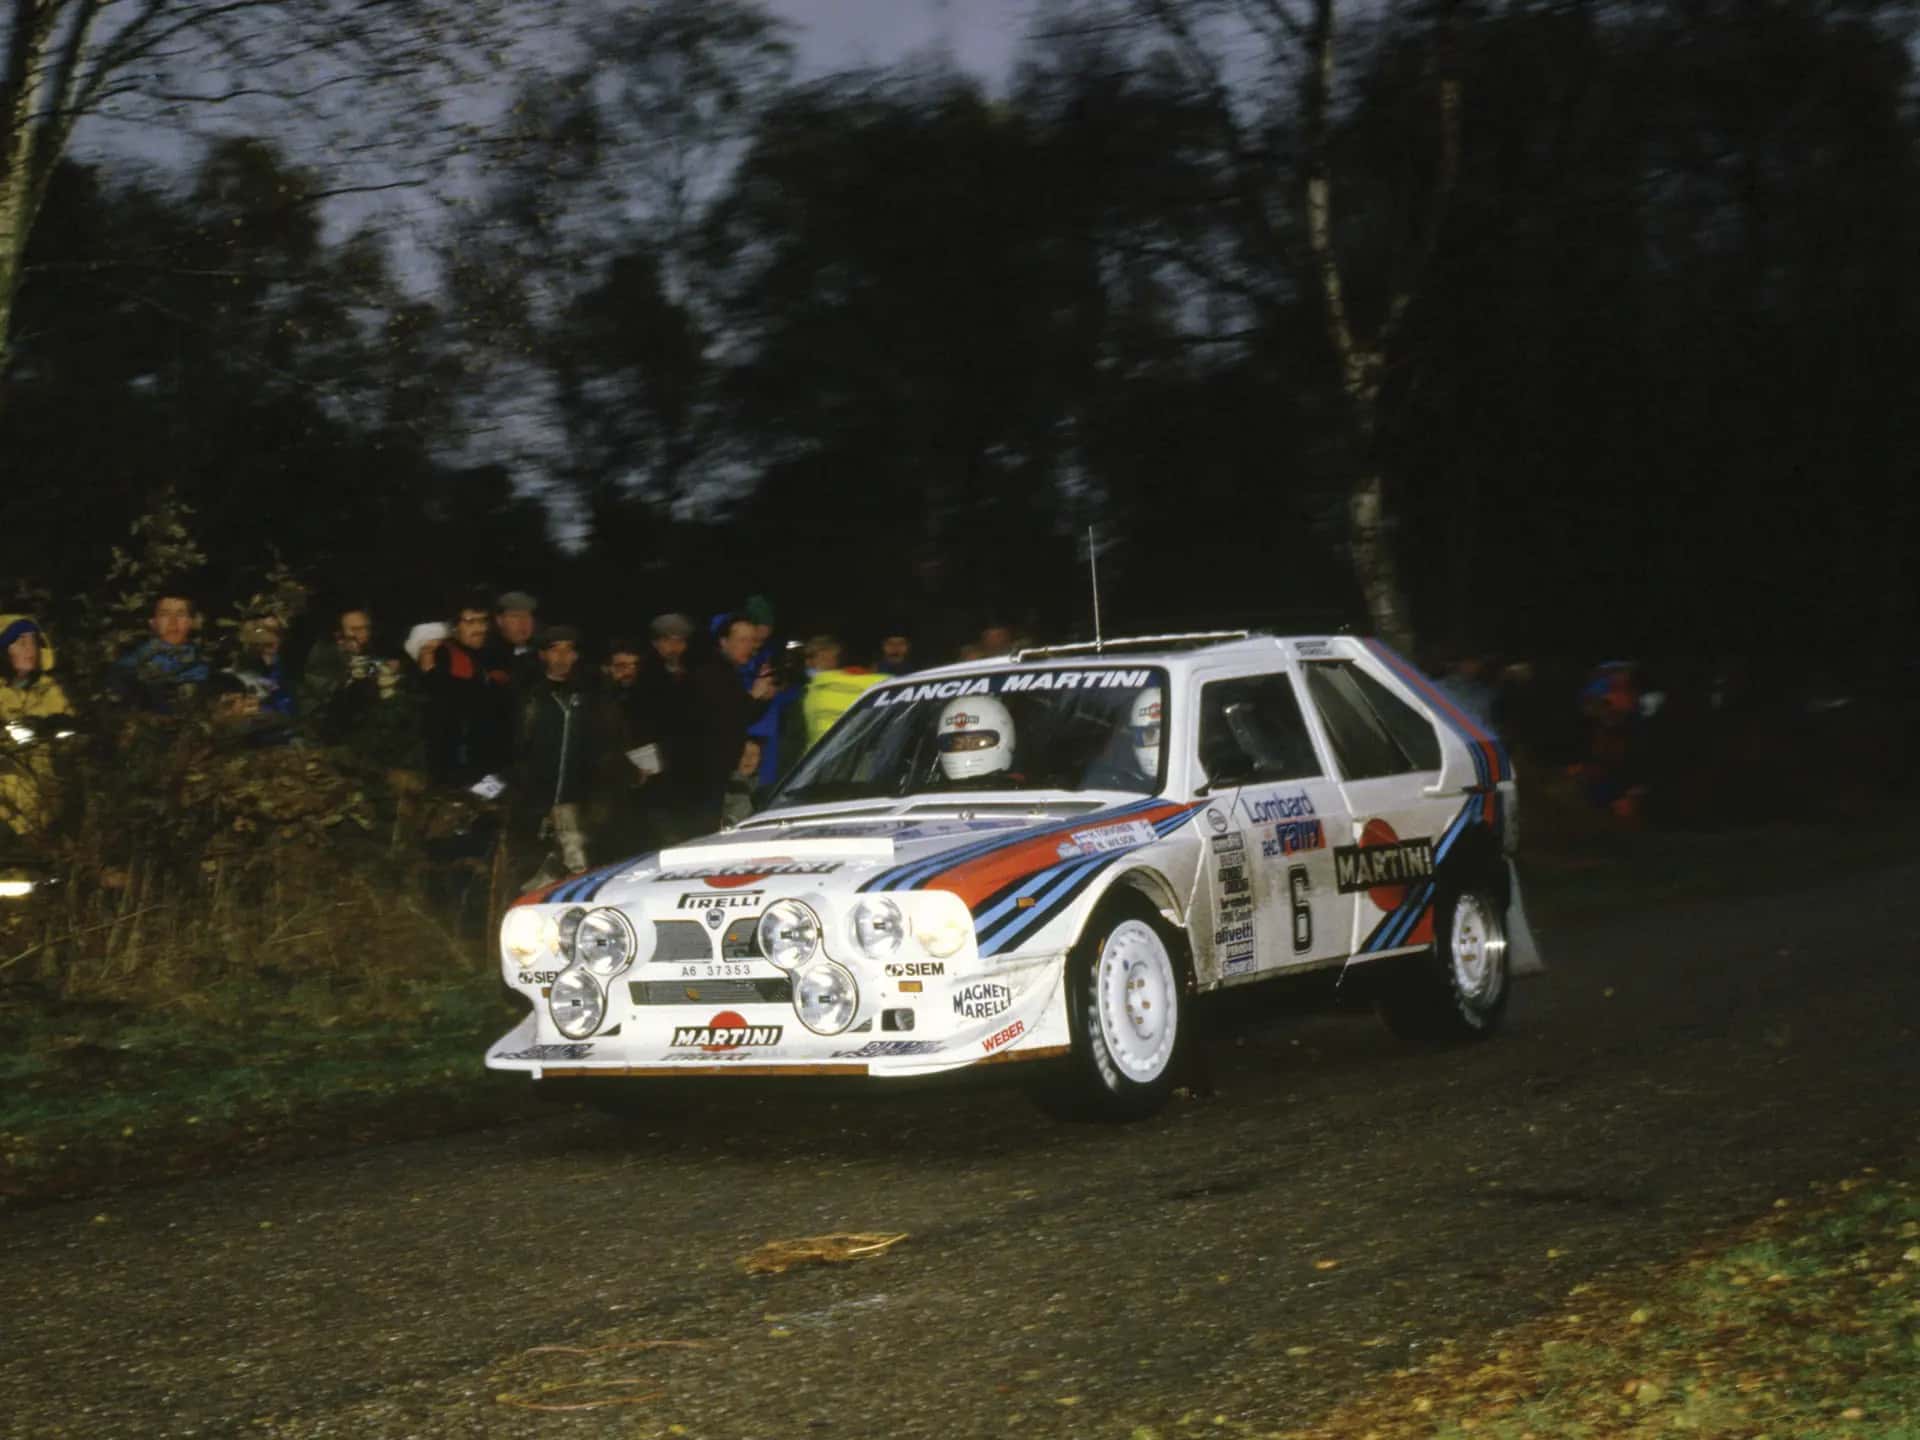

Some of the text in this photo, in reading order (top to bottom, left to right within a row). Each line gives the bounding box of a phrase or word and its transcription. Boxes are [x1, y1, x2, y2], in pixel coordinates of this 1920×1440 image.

[873, 669, 1151, 707] LANCIA MARTINI
[1239, 789, 1315, 824] Lombard
[1337, 846, 1433, 886] MARTINI
[677, 889, 766, 909] PIRELLI
[1287, 864, 1312, 955] 6
[1215, 920, 1254, 945] olivetti
[682, 964, 751, 977] A6 37353
[905, 962, 945, 977] SIEM
[953, 983, 1012, 1010] MAGNETI
[954, 996, 1012, 1018] MARELLI
[675, 1028, 780, 1047] MARTINI
[982, 1020, 1025, 1053] WEBER
